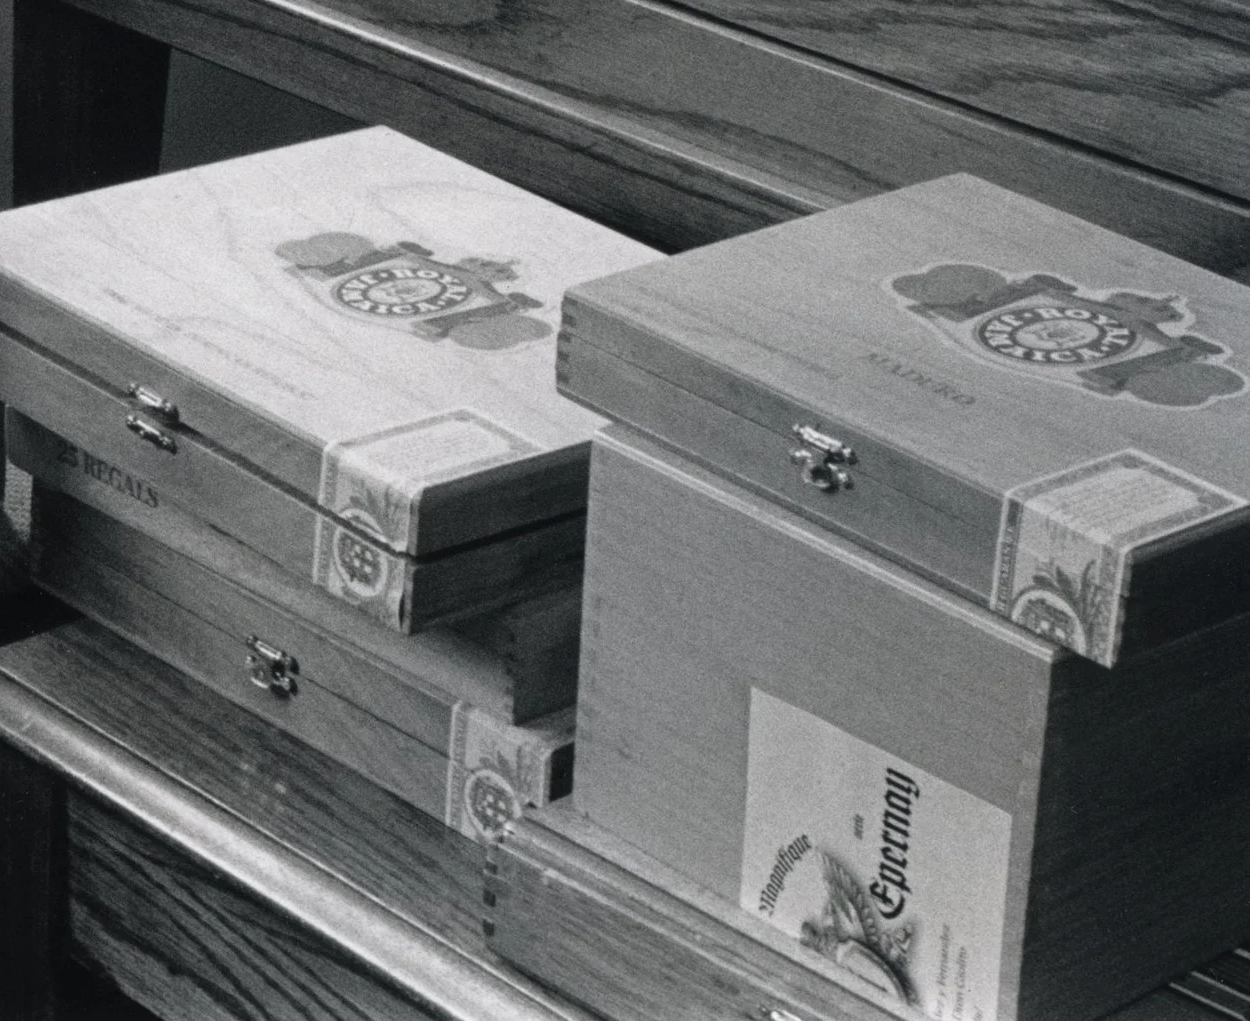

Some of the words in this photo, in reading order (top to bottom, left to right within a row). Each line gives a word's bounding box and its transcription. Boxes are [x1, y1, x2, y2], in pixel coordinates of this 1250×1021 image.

[57, 439, 79, 468] 25
[82, 450, 160, 509] REGALS
[758, 833, 813, 917] Magnifique
[868, 766, 921, 920] Epernay
